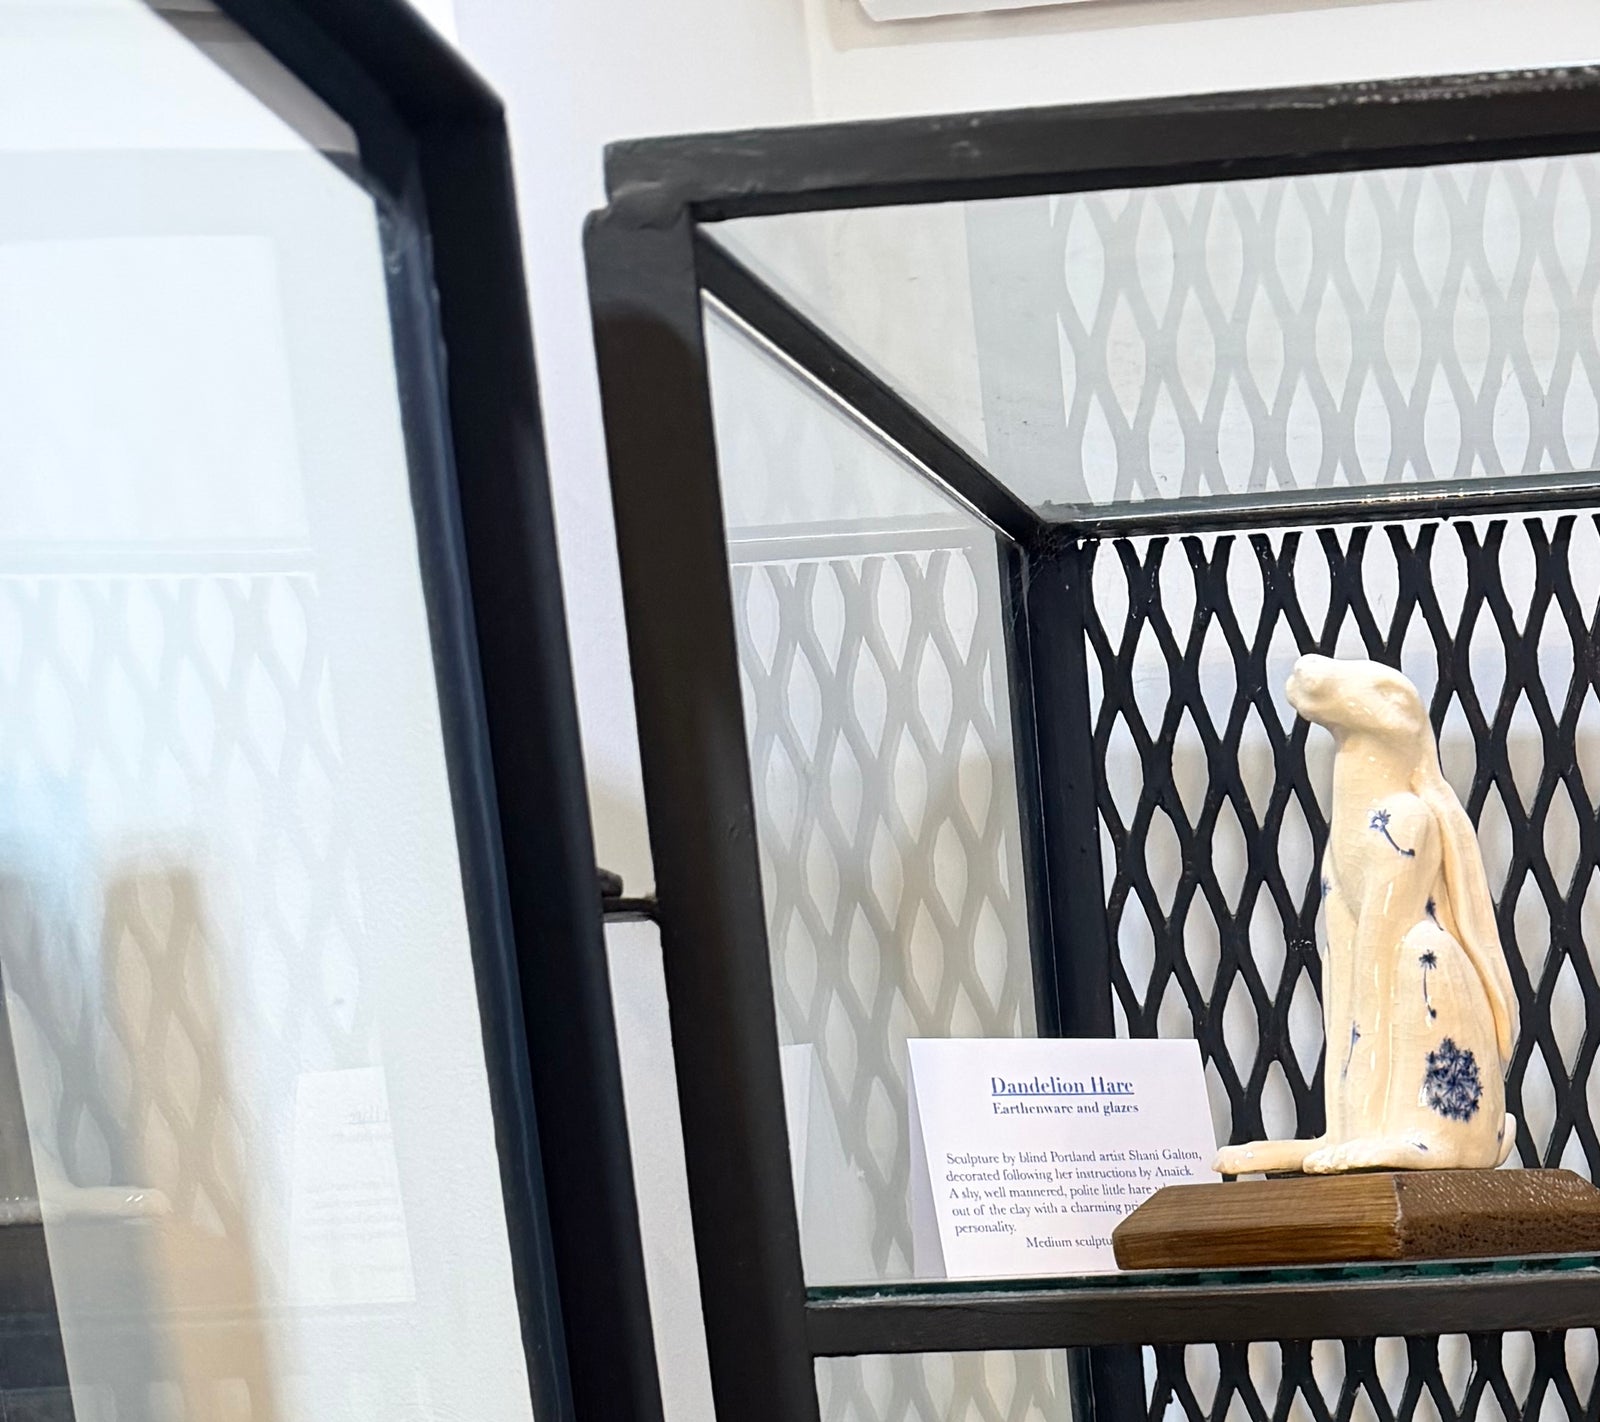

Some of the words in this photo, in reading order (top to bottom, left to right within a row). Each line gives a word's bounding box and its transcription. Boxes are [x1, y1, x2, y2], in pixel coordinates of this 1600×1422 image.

[991, 1076, 1085, 1094] Dandelion
[1090, 1076, 1134, 1094] Hare
[992, 1101, 1073, 1114] Earthenware
[1076, 1101, 1099, 1113] and
[1102, 1100, 1139, 1117] glazes
[946, 1152, 999, 1167] Sculpture
[1001, 1151, 1015, 1166] by
[1018, 1151, 1047, 1163] blind
[1049, 1149, 1096, 1163] Portland
[1099, 1149, 1126, 1162] artist
[1128, 1149, 1159, 1161] Shani
[954, 1220, 1016, 1237] personality.
